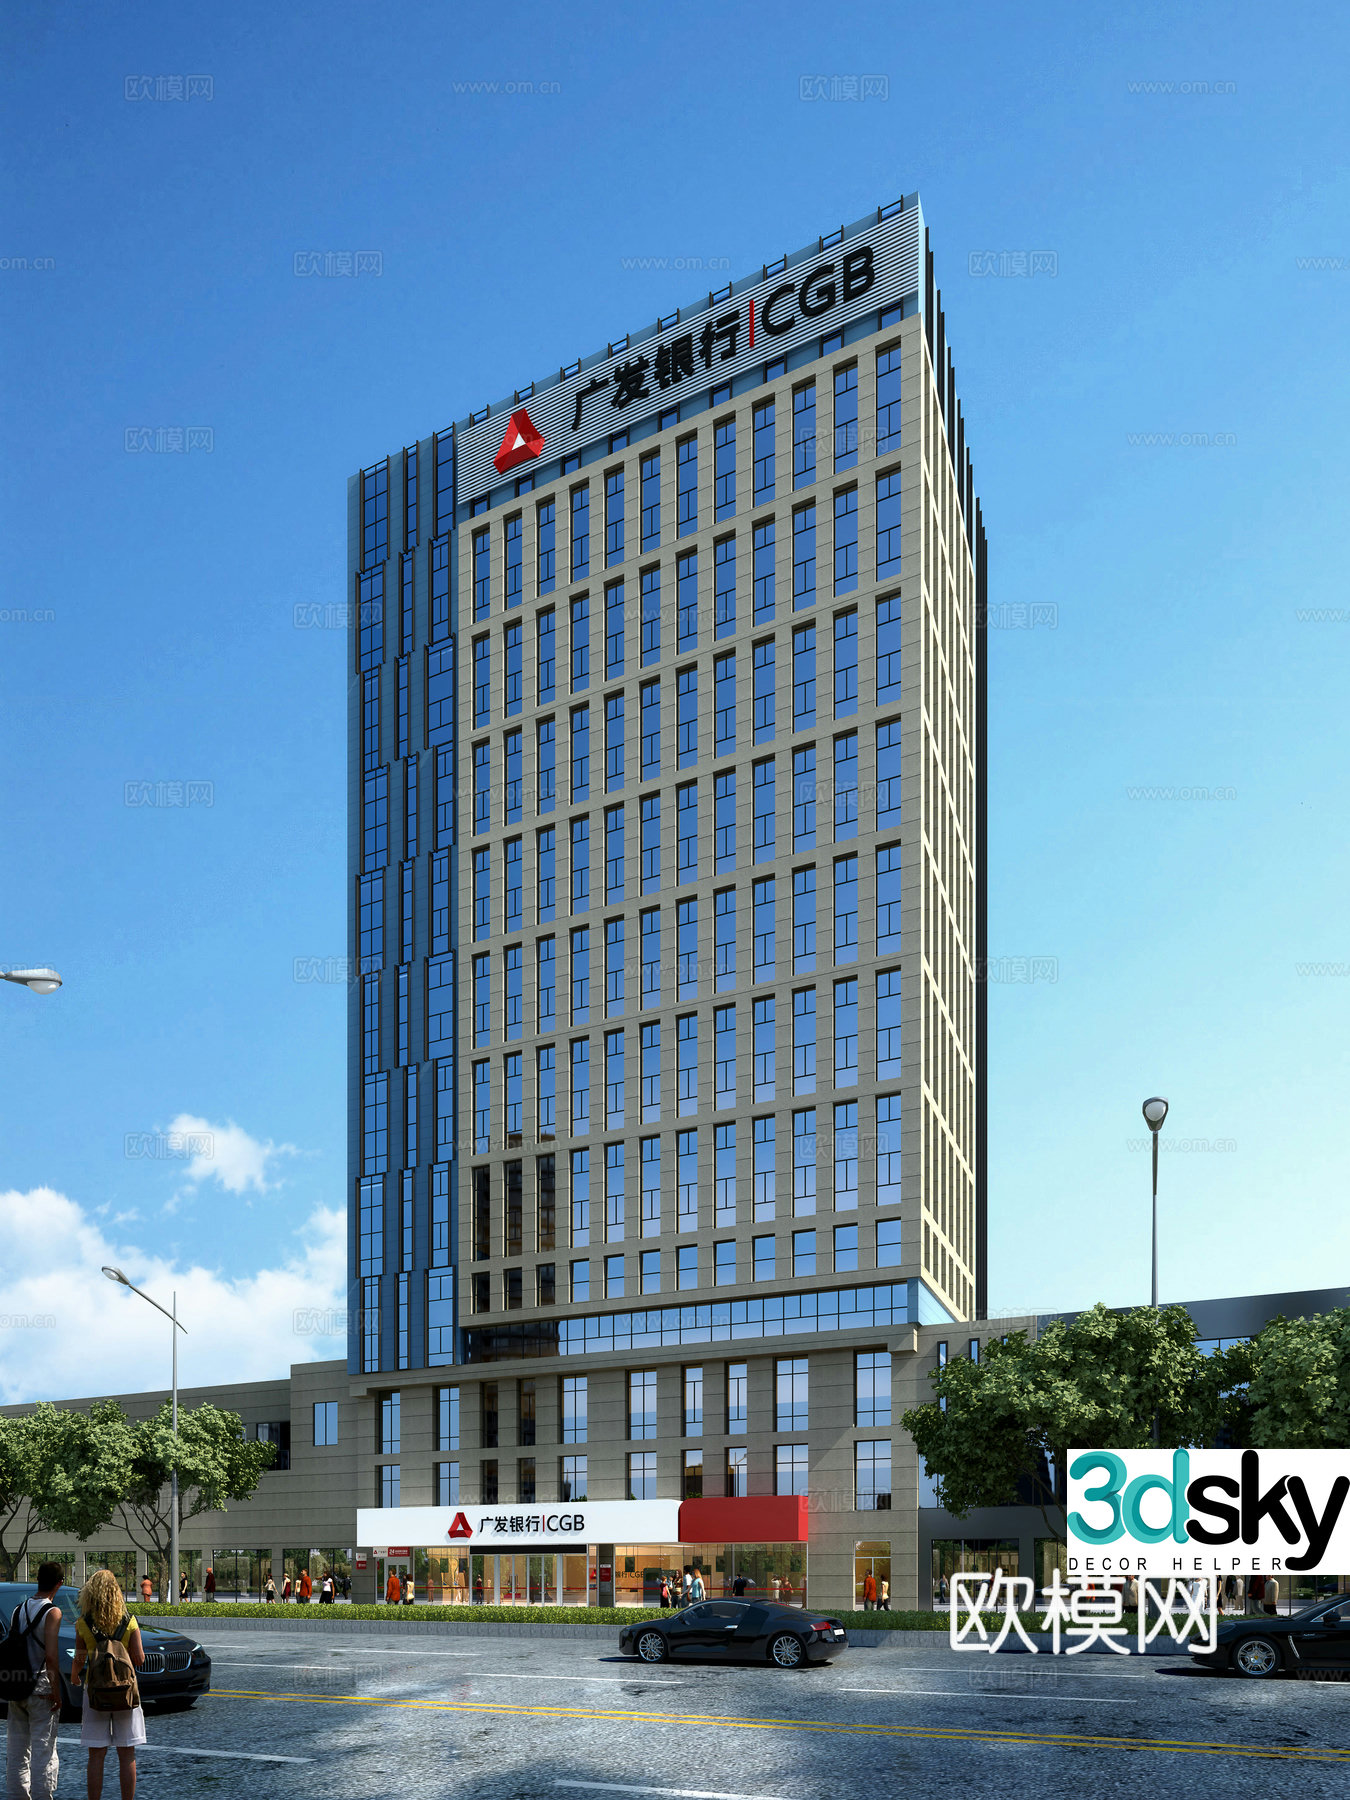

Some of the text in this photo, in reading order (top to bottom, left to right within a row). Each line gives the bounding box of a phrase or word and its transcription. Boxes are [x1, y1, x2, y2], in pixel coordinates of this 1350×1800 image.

[571, 245, 875, 431] 广发银行 CGB
[480, 1515, 585, 1533] 广发银行 CGB
